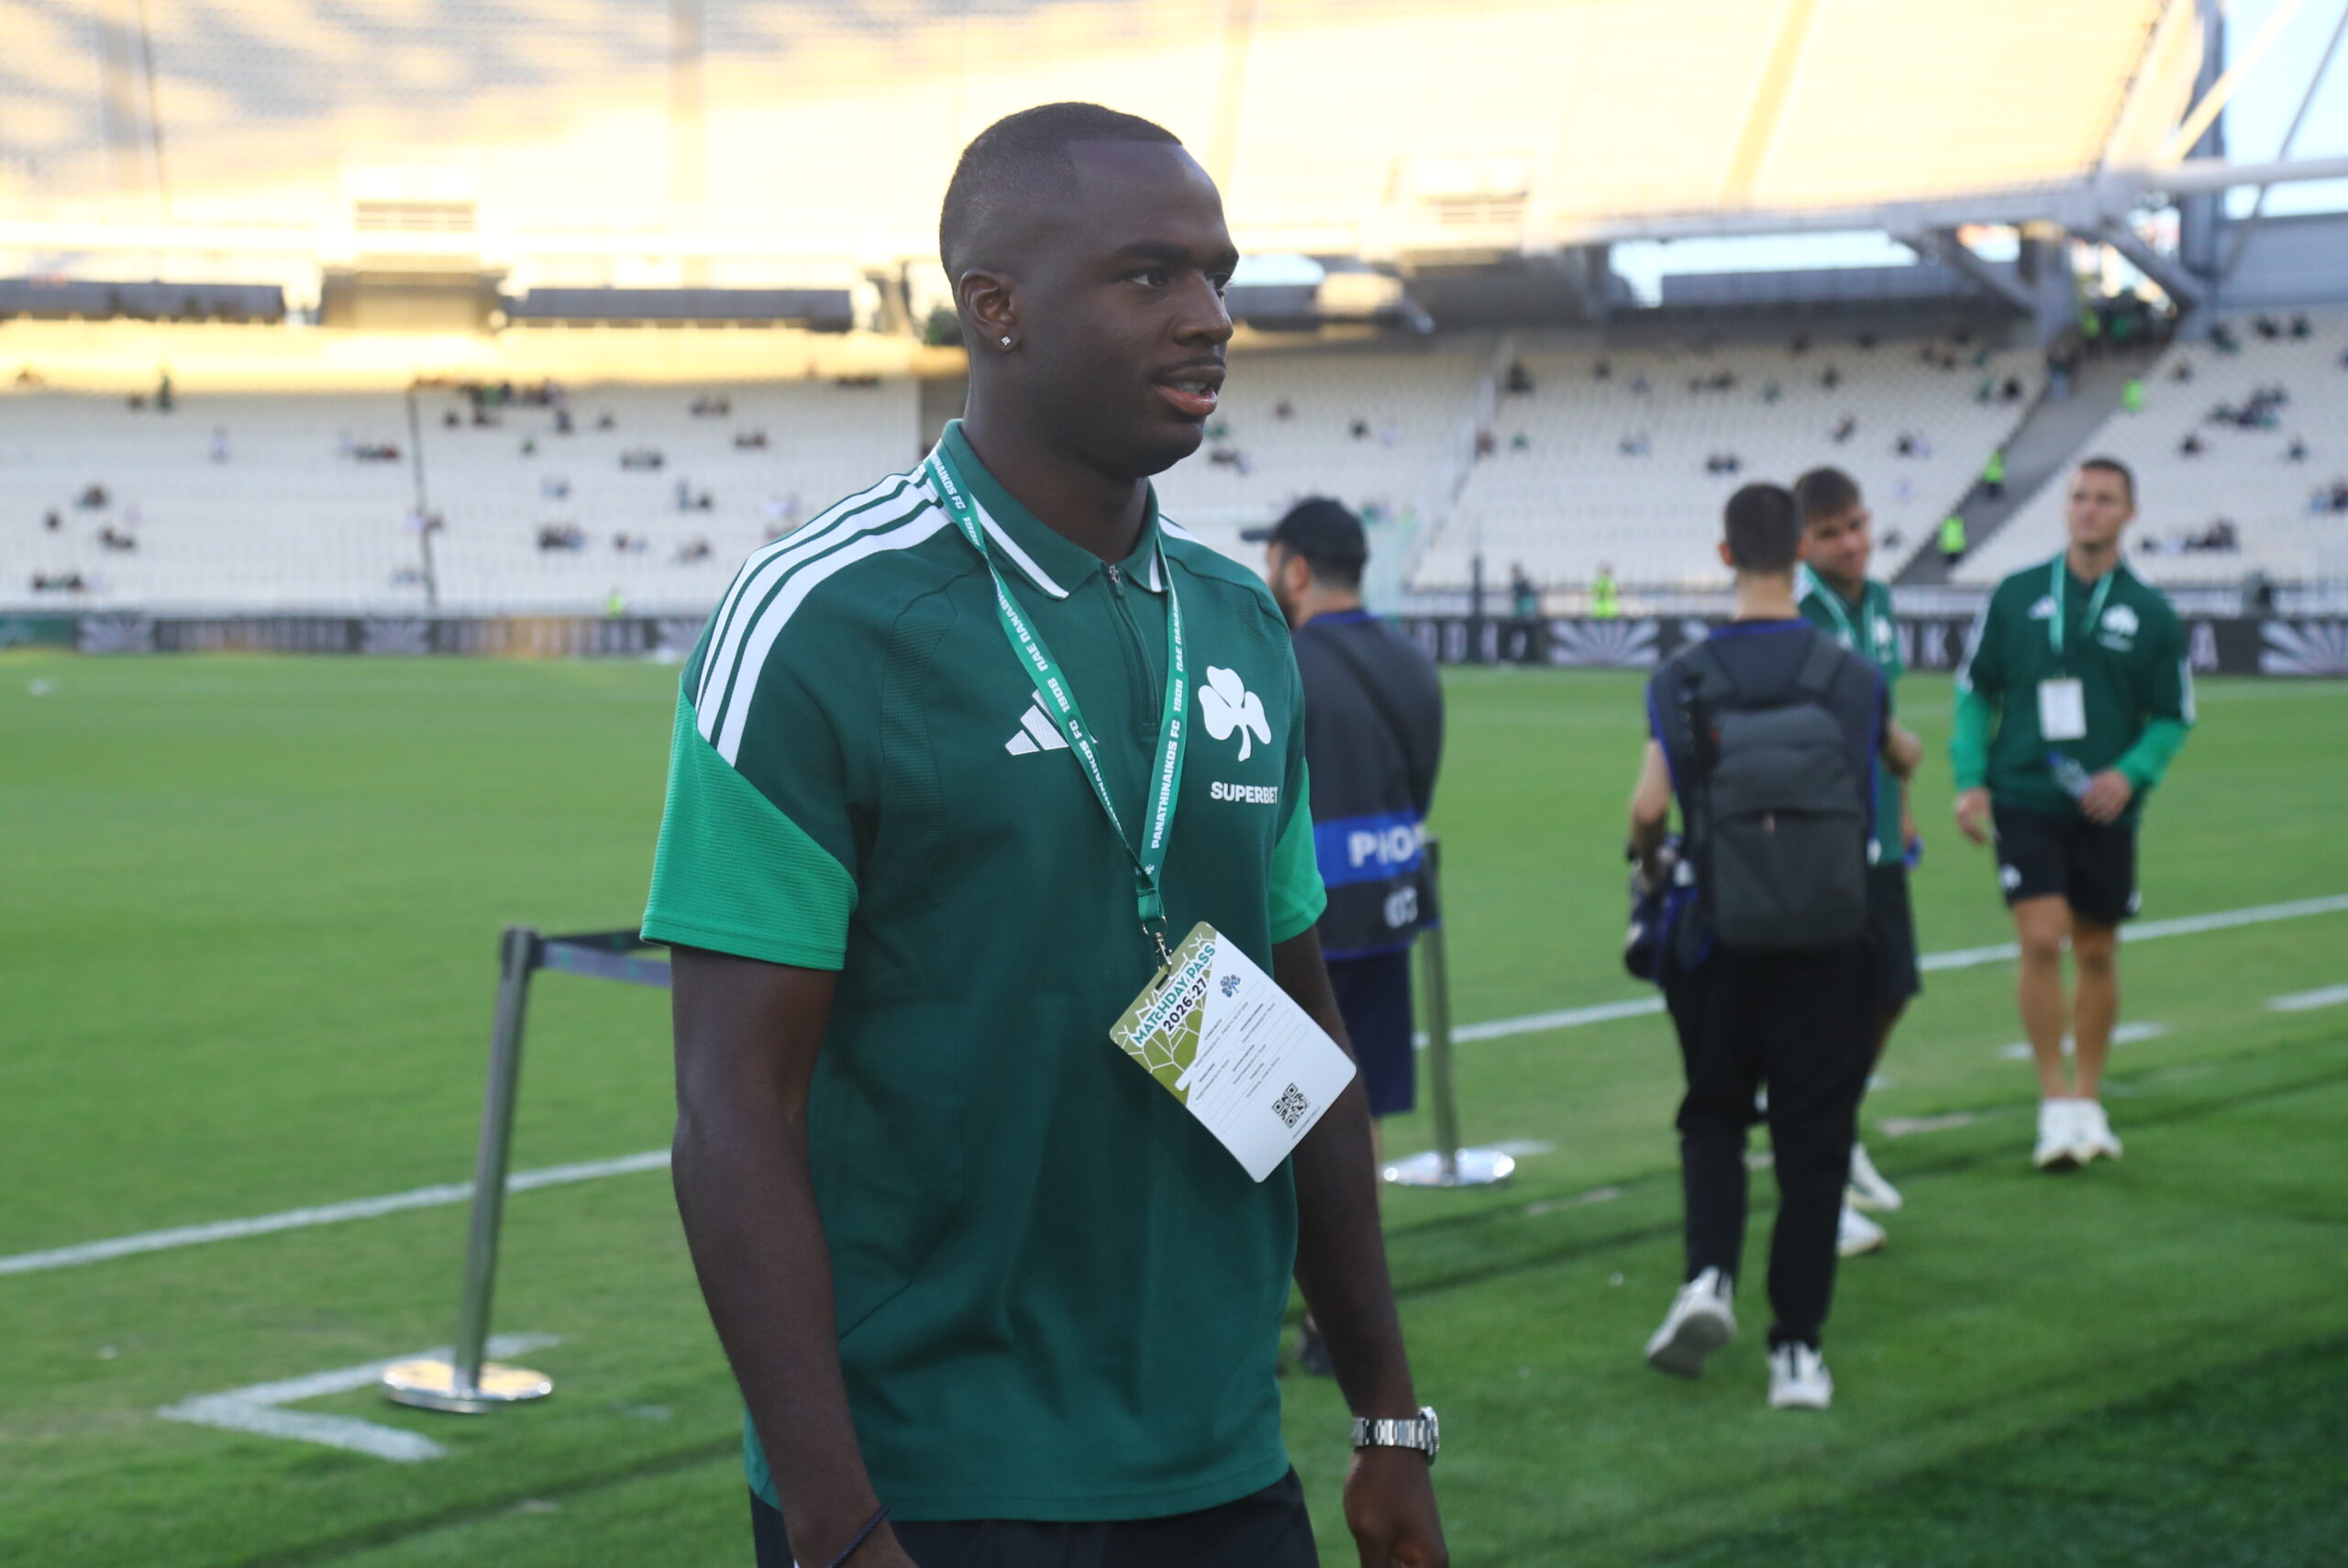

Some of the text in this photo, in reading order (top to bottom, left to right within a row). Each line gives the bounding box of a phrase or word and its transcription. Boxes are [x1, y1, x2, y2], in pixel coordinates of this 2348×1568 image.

[951, 495, 967, 510] FC
[1047, 678, 1070, 712] 1908
[1069, 719, 1083, 740] FC
[1151, 679, 1184, 849] PANATHINAIKOS FC 1908
[1211, 781, 1279, 804] SUPERBET
[1186, 944, 1216, 979] PASS
[1163, 977, 1207, 1032] 2026-27
